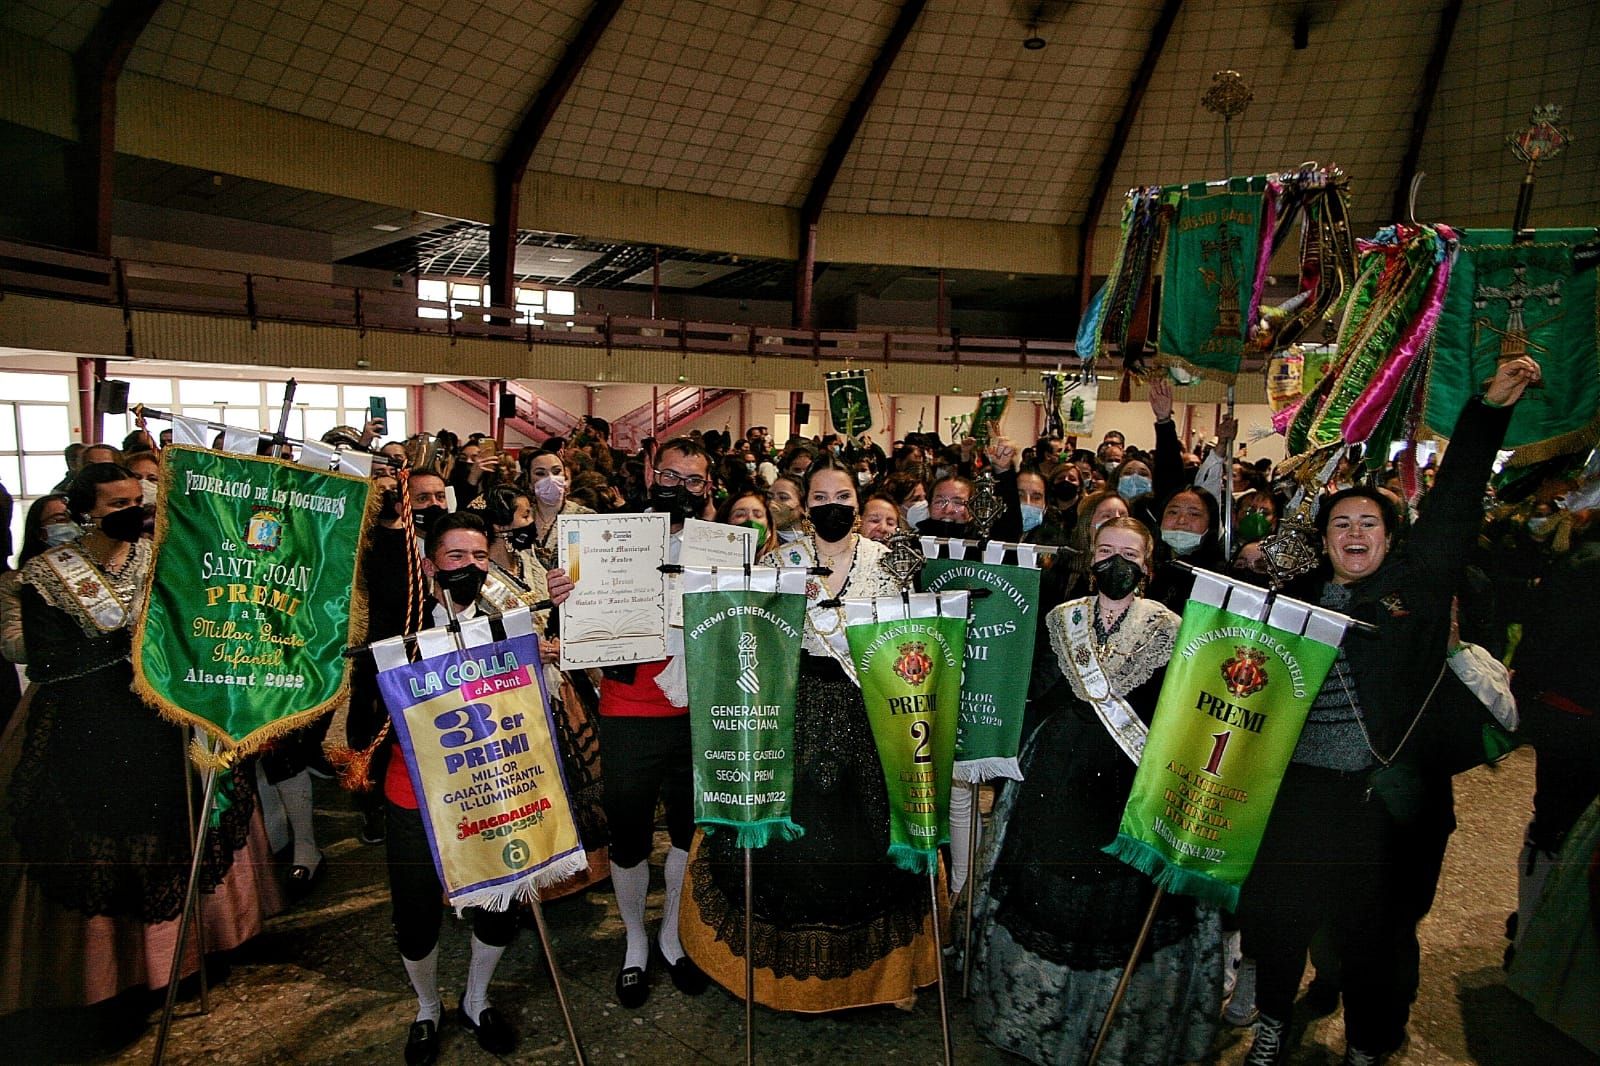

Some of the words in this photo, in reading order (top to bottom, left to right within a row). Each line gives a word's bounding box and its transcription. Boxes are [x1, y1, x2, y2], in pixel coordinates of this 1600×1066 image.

[185, 470, 251, 499] FEDERACIÓ
[254, 486, 269, 500] DE
[290, 491, 347, 520] FOGUERES
[221, 539, 237, 551] de
[616, 545, 651, 553] Municipal
[202, 552, 257, 580] SANT
[262, 562, 313, 592] JOAN
[205, 583, 301, 617] PREMI
[977, 569, 1030, 615] GESTORA
[241, 610, 249, 619] a
[255, 608, 266, 621] la
[690, 611, 725, 640] PREMI
[727, 606, 798, 638] GENERALITAT
[911, 624, 926, 634] DE
[193, 617, 254, 639] Millor
[259, 622, 307, 647] Gaiata
[212, 643, 283, 669] Infantil
[1181, 627, 1258, 661] AJUNTAMENT
[1259, 633, 1276, 648] DE
[1274, 644, 1307, 699] CASTELLÓ
[183, 668, 257, 686] Alacant
[264, 672, 305, 689] 2022
[409, 671, 443, 699] LA
[445, 651, 519, 687] COLLA
[495, 675, 521, 691] Punt
[710, 705, 780, 717] GENERALITAT
[712, 719, 778, 730] VALENCIANA
[1195, 690, 1268, 734] PREMI
[444, 733, 530, 775] PREMI
[704, 750, 736, 760] GAIATES
[738, 751, 751, 761] DE
[753, 747, 785, 760] CASTELLÓ
[910, 720, 933, 765] 2
[1201, 730, 1233, 780] 1
[471, 760, 518, 783] MILLOR
[716, 768, 751, 782] SEGÓN
[754, 769, 774, 782] PREMI
[1166, 759, 1177, 773] A
[442, 782, 493, 805] GAIATA
[495, 765, 545, 789] INFANTIL
[460, 780, 538, 812] IL·LUMINADA
[703, 791, 766, 806] MAGDALENA
[766, 791, 786, 803] 2022
[457, 798, 552, 840] MAGDALENA
[481, 814, 539, 841] 2022
[1152, 816, 1201, 858] MAGDALENA
[1200, 847, 1226, 864] 2022
